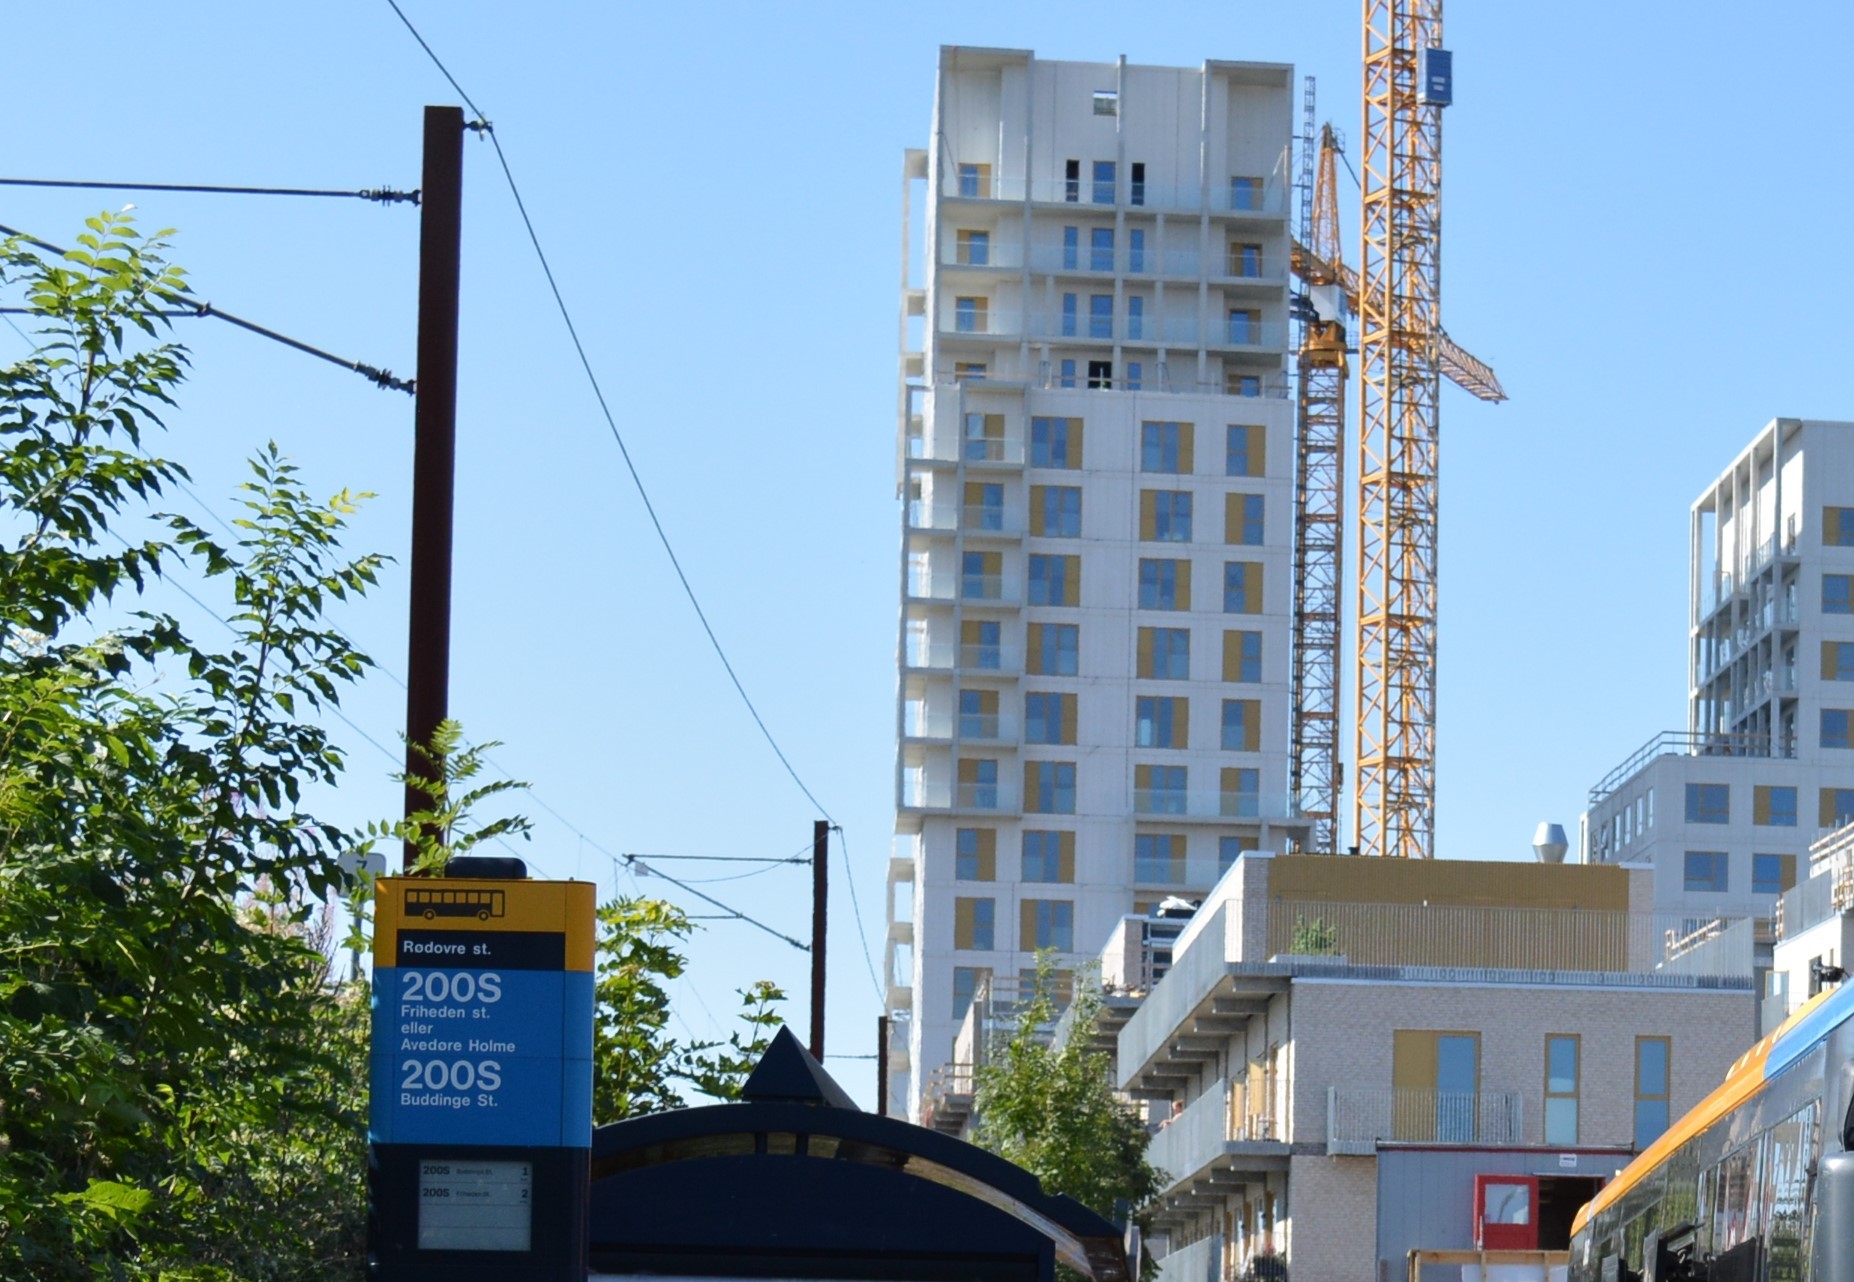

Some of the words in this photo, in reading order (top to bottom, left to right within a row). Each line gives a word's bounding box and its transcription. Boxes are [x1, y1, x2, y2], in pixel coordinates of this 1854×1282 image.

[403, 940, 467, 955] Rødovre
[472, 943, 492, 956] st.
[401, 971, 503, 1004] 200S
[401, 1004, 466, 1018] Friheden
[472, 1006, 491, 1019] st.
[401, 1021, 434, 1034] eller
[401, 1037, 463, 1052] Avedøre
[468, 1039, 516, 1053] Holme
[401, 1058, 502, 1092] 200S
[400, 1092, 471, 1109] Buddinge
[477, 1093, 499, 1108] St.
